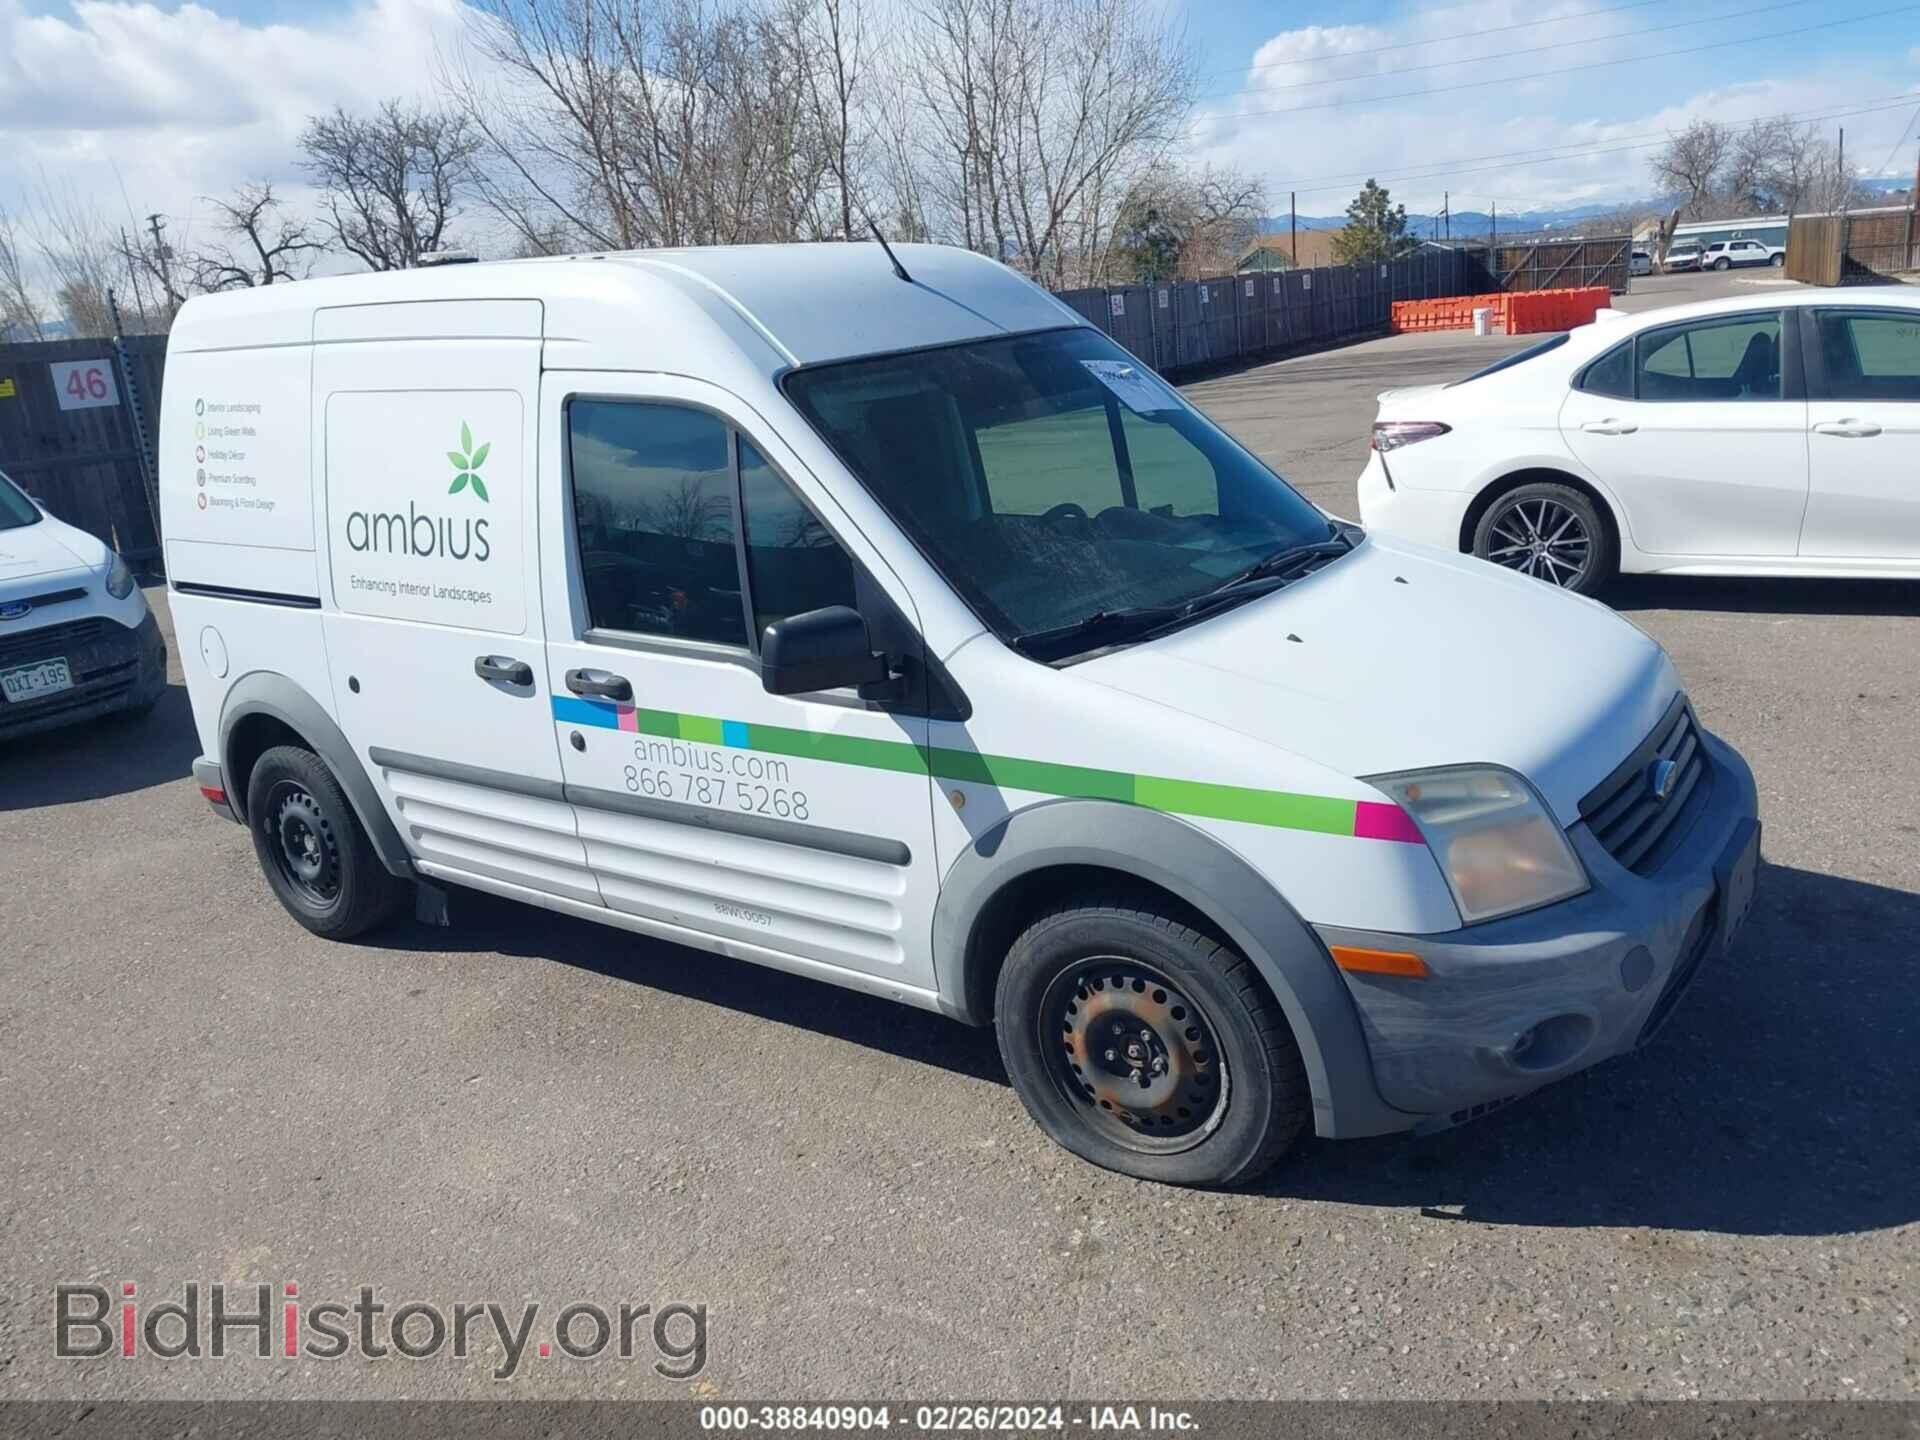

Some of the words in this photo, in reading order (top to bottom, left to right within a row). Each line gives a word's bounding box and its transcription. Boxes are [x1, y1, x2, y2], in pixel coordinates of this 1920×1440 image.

[66, 367, 108, 400] 46
[346, 500, 490, 562] ambius
[350, 574, 397, 597] Enhancing
[398, 579, 431, 597] Interior
[432, 583, 493, 605] Landscapes
[633, 738, 790, 784] ambius.com
[623, 764, 673, 798] 866
[679, 772, 726, 806] 787
[736, 781, 810, 821] 5268
